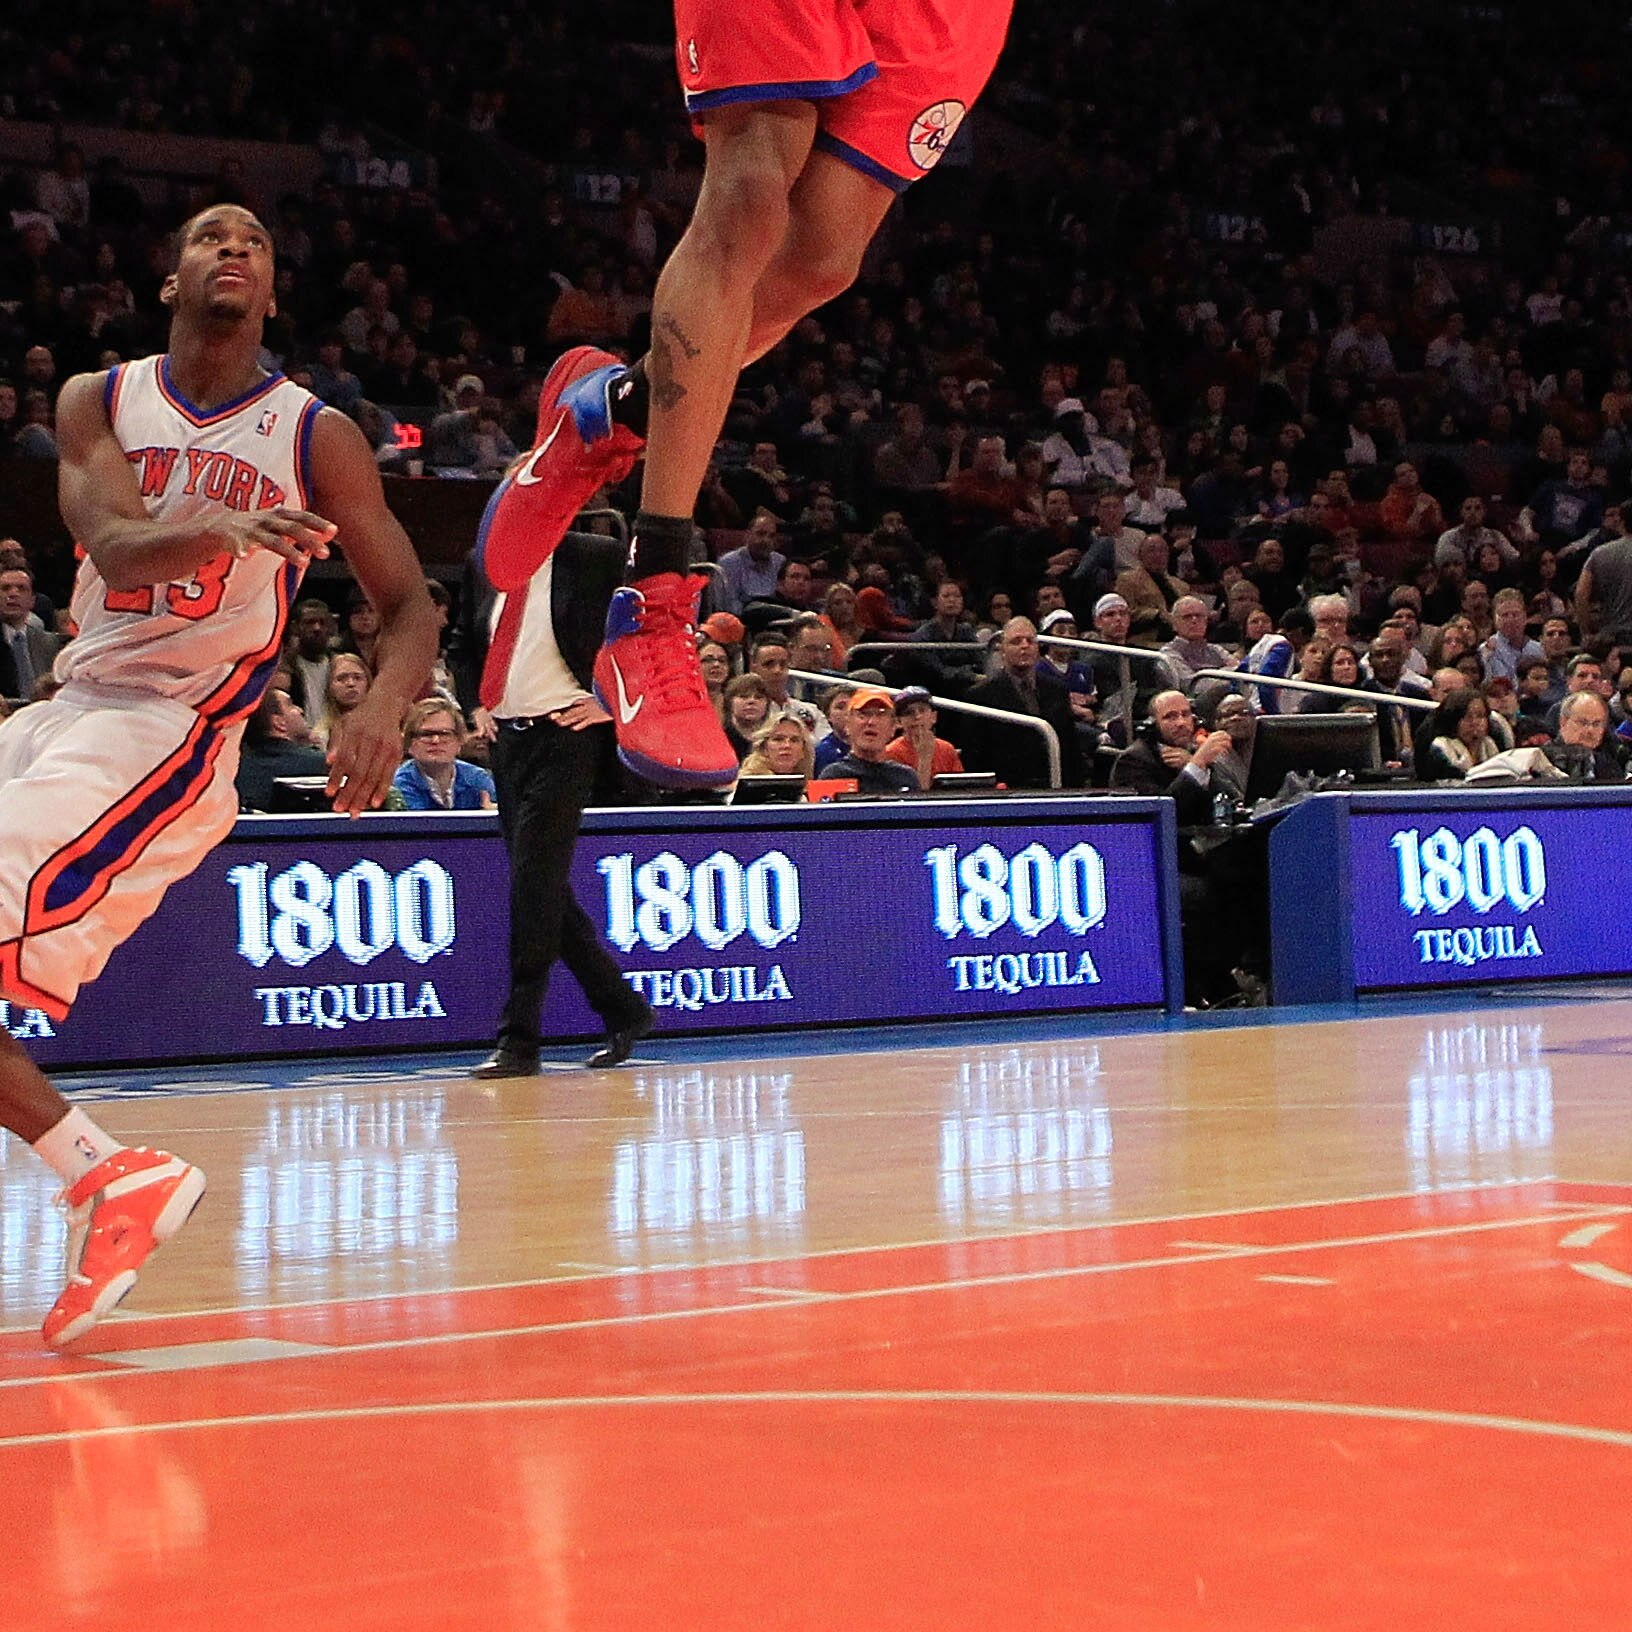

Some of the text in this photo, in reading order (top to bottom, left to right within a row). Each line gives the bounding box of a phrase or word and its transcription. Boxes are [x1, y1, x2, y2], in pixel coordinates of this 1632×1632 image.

[596, 849, 801, 954] 1800
[923, 841, 1107, 940] 1800
[1390, 825, 1547, 917] 1800
[227, 859, 456, 968] 1800
[1413, 924, 1543, 967] TEQUILA
[254, 982, 447, 1030] TEQUILA
[622, 965, 794, 1011] TEQUILA
[947, 950, 1101, 995] TEQUILA
